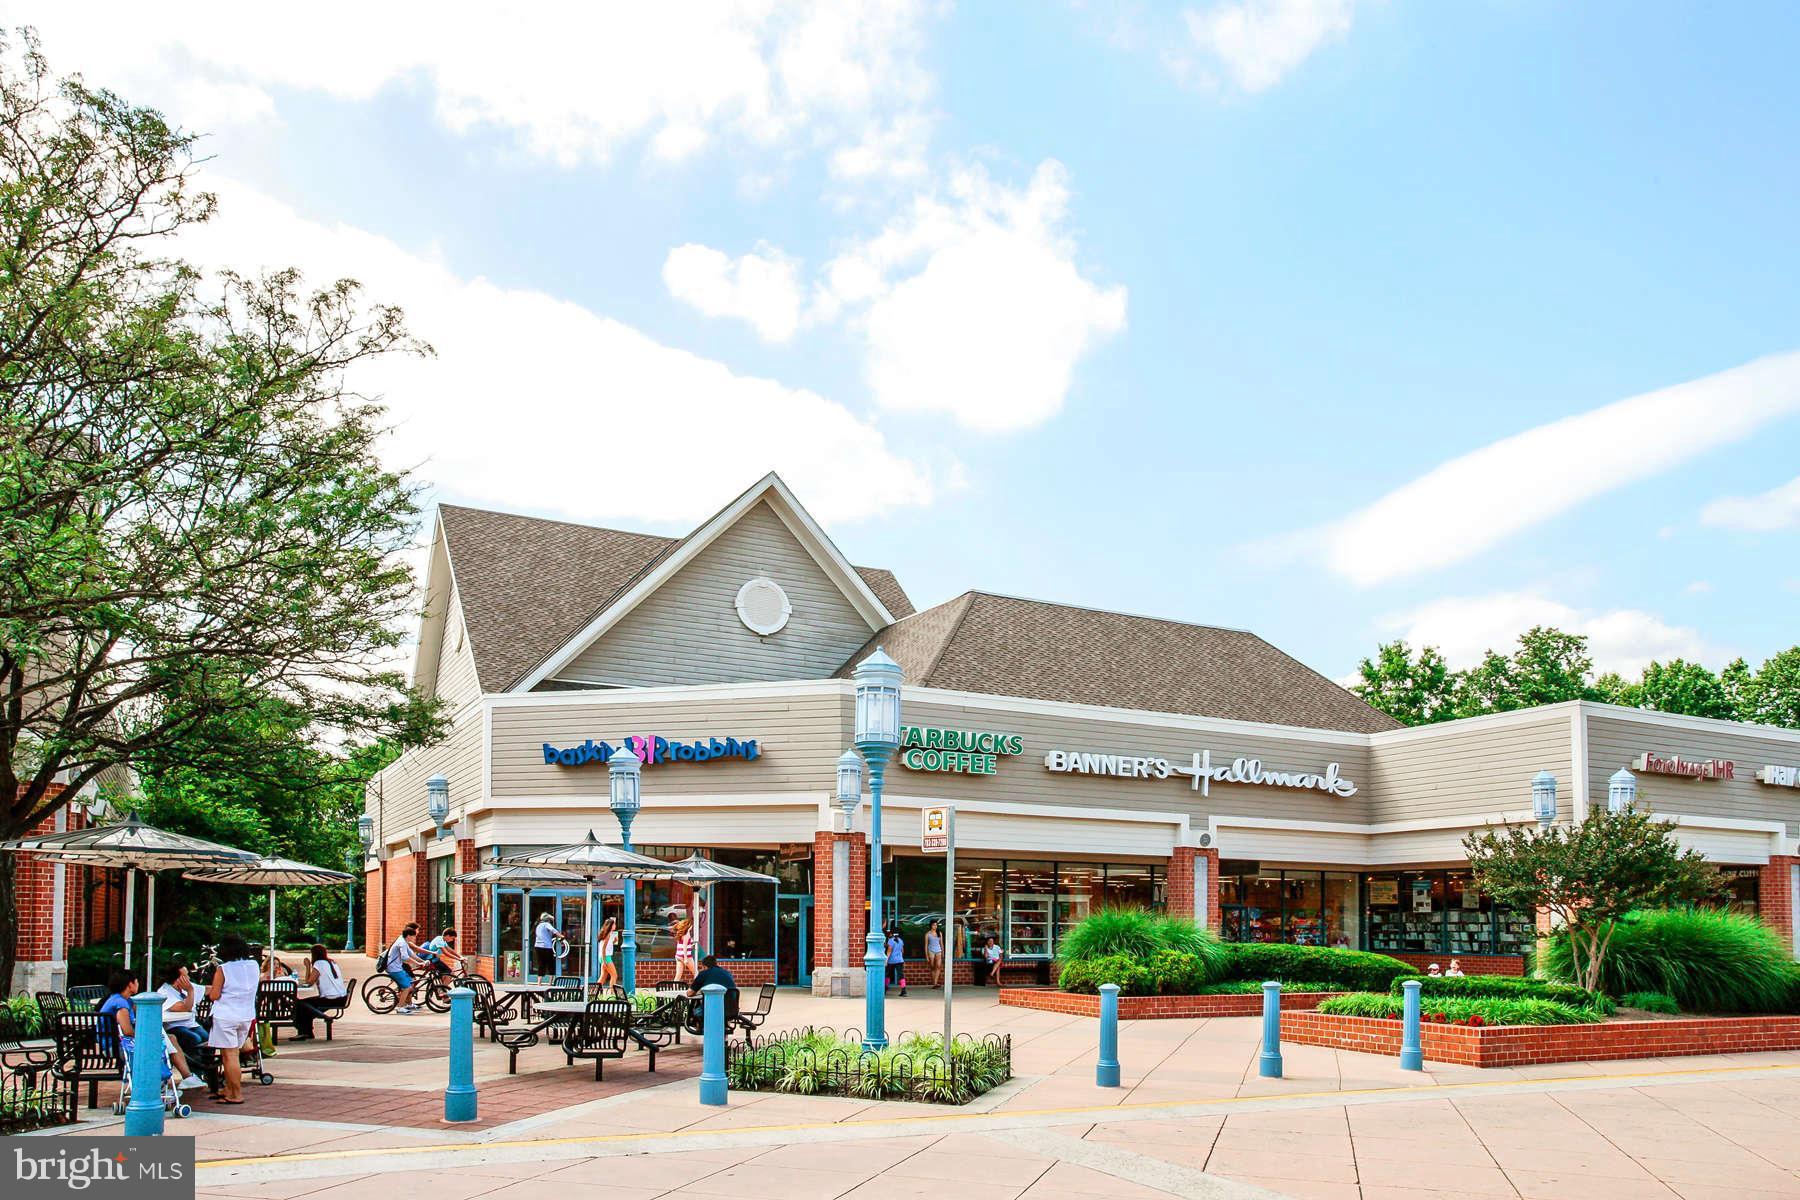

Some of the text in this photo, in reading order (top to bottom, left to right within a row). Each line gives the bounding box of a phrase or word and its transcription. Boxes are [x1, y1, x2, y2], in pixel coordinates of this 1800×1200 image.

[669, 736, 757, 762] robbins
[900, 725, 1024, 755] TARBUCKS
[905, 748, 997, 775] COFFEE
[1048, 750, 1358, 797] BANNER'S Hallmark
